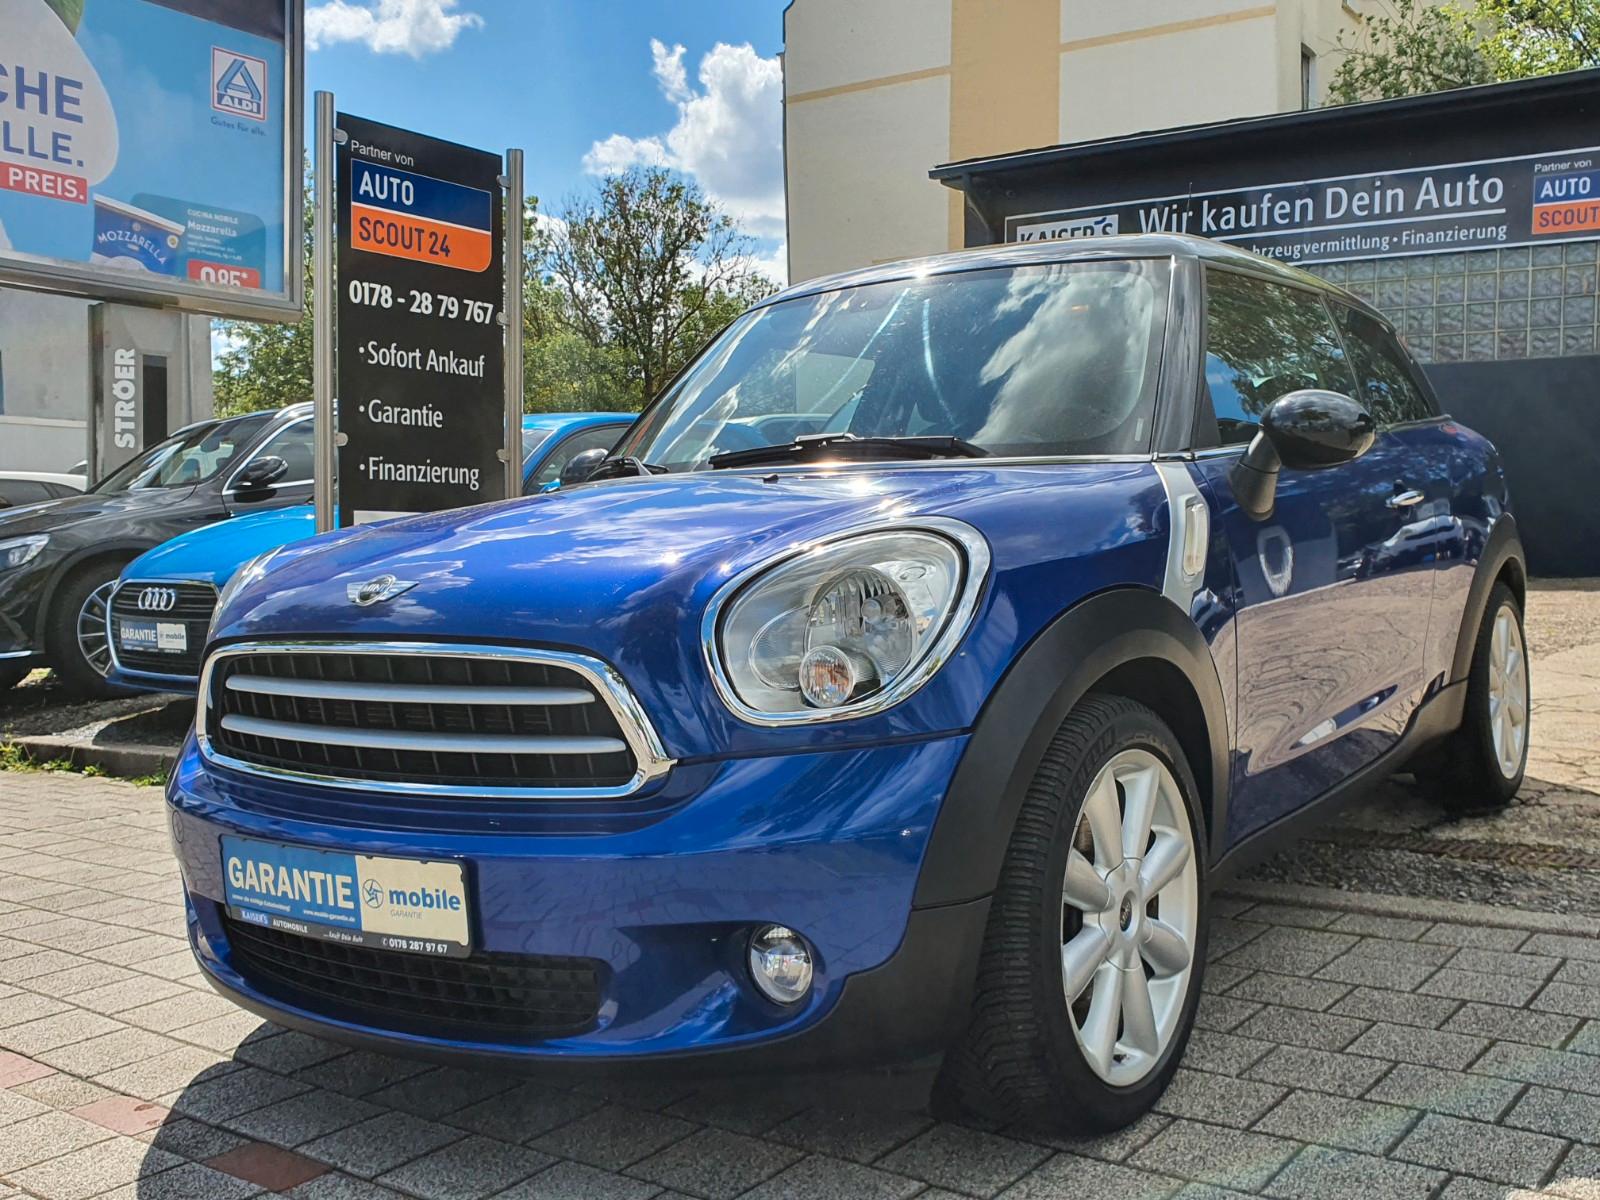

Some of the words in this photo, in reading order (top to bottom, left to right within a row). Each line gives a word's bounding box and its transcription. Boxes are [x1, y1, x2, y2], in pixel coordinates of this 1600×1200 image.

[0, 63, 83, 123] HE
[221, 95, 258, 112] ALDI
[351, 139, 391, 161] Partner
[394, 153, 414, 167] von
[1534, 162, 1570, 173] Partner
[1574, 160, 1592, 168] von
[8, 167, 84, 200] PREIS.
[359, 171, 414, 206] AUTO
[1540, 176, 1591, 199] AUTO
[1139, 204, 1193, 234] Wir
[1202, 193, 1313, 233] kaufen
[1325, 180, 1405, 219] Dein
[1415, 174, 1504, 211] Auto
[188, 220, 237, 237] Mozzarella
[1252, 234, 1390, 259] hrzeugvermittlung
[1402, 222, 1507, 247] Finanzierung
[97, 230, 167, 264] MOZZARELLA
[349, 279, 392, 309] 0178
[409, 289, 433, 315] 28
[437, 294, 459, 319] 79
[463, 299, 493, 325] 767
[367, 341, 421, 370] Sofort
[425, 348, 485, 378] Ankauf
[112, 348, 136, 448] STRÖER
[368, 399, 443, 428] Garantie
[369, 456, 480, 491] Finanzierung
[120, 627, 157, 641] GARANTIE
[165, 632, 185, 641] mobile
[228, 856, 355, 910] GARANTIE
[389, 887, 461, 911] mobile
[272, 919, 308, 934] AUTOMOBILE
[390, 909, 424, 920] GARANTIE
[389, 938, 408, 950] 0178
[409, 940, 424, 951] 287
[425, 942, 436, 953] 97
[437, 944, 448, 954] 67
